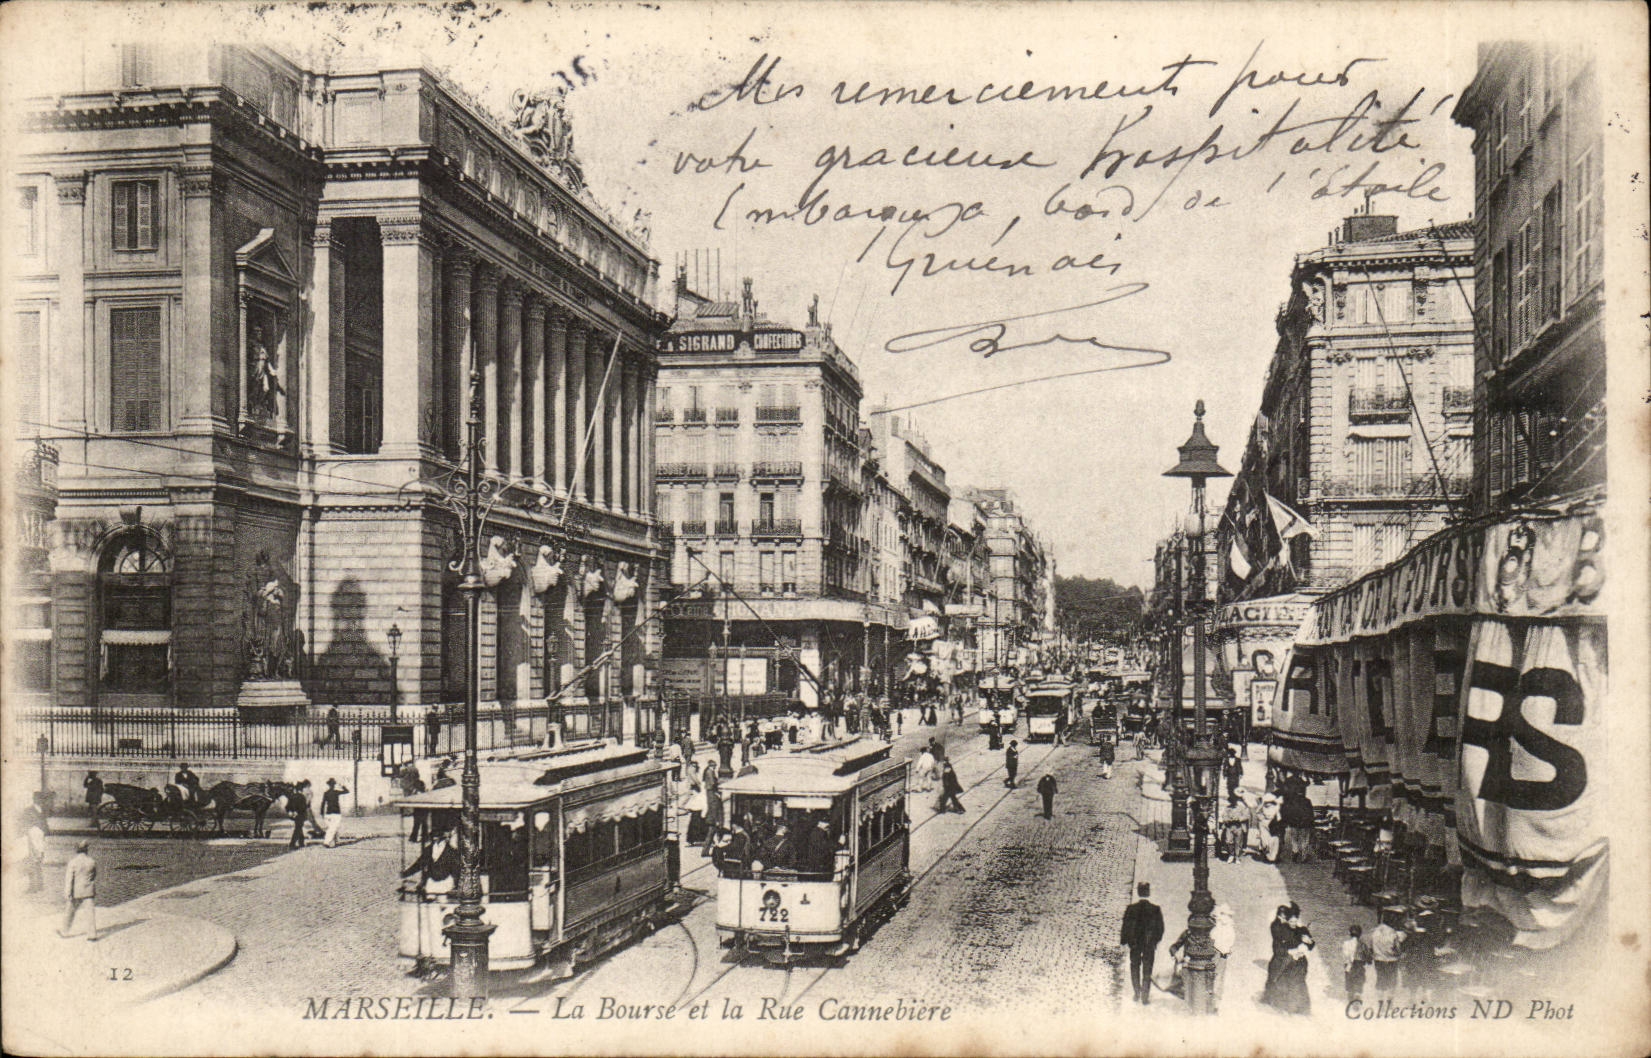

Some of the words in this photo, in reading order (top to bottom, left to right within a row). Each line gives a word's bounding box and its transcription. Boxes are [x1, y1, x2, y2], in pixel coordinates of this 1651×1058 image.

[831, 50, 1218, 106] remerciements
[1210, 40, 1387, 117] pour
[802, 124, 1057, 198] gracieuse
[679, 334, 736, 352] SIGRAND
[758, 906, 790, 923] 722
